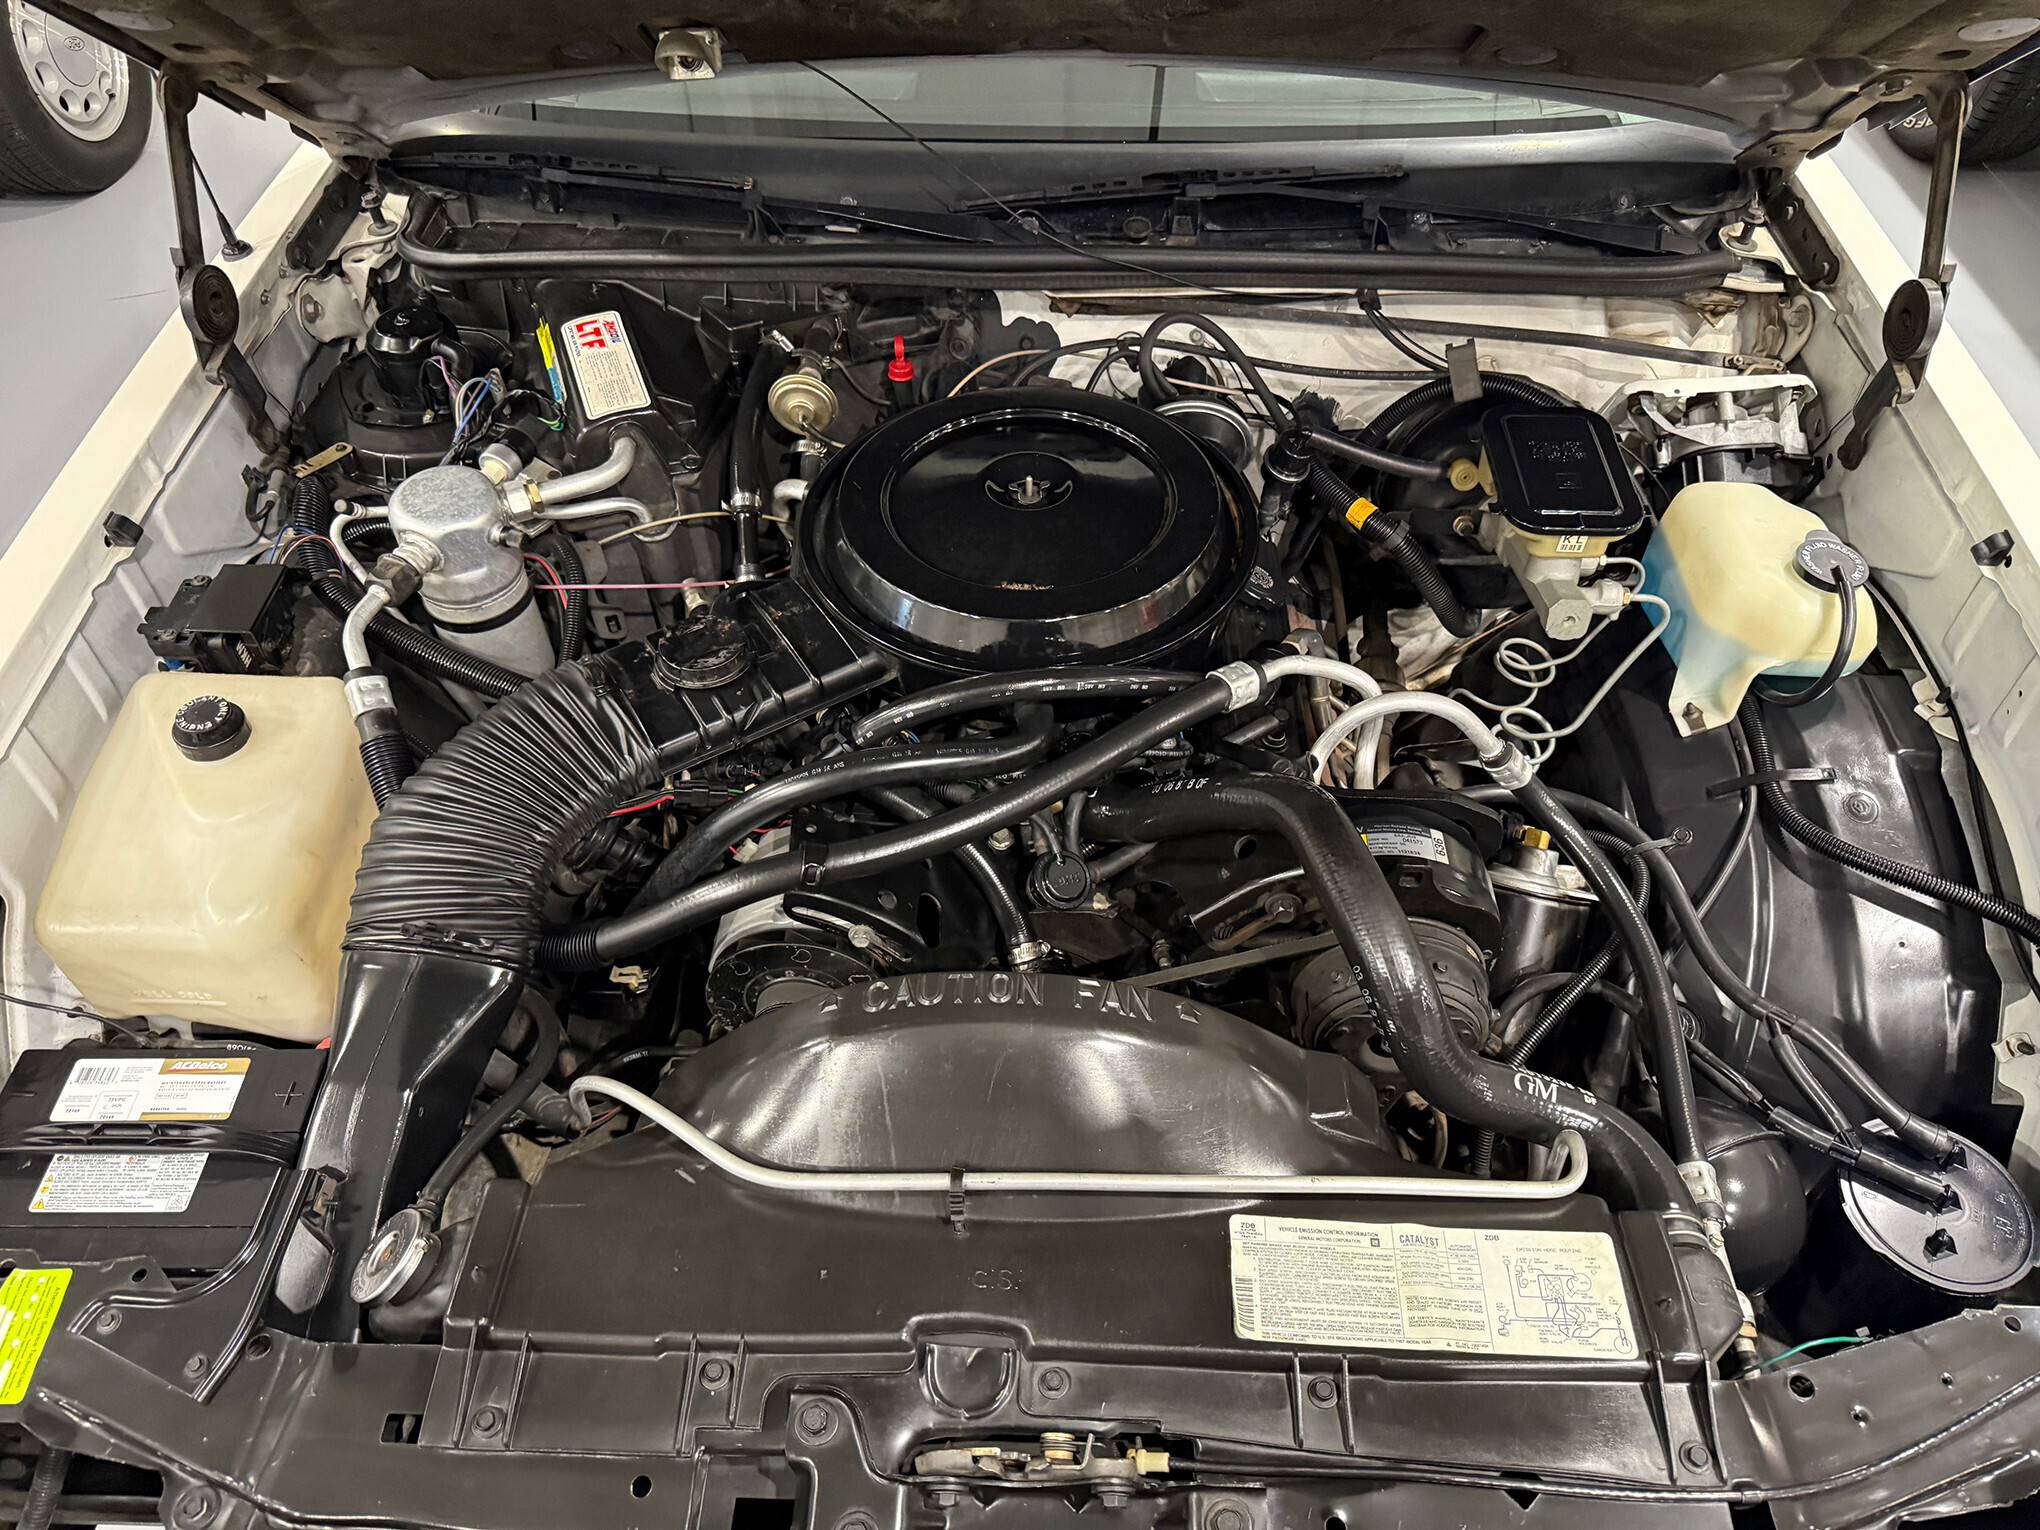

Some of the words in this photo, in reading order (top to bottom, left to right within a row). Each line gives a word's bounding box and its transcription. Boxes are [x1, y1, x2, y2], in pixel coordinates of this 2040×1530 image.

[575, 319, 607, 349] LTF
[176, 694, 223, 716] COOLANT
[213, 701, 230, 723] ONLY
[175, 716, 213, 730] ENGINE
[1433, 837, 1446, 857] 636
[1352, 965, 1364, 981] 03
[862, 972, 1045, 1014] CAUTION
[1072, 977, 1157, 1023] FAN
[168, 1060, 229, 1070] ACDelco
[1513, 1072, 1559, 1104] GM
[1399, 1234, 1439, 1247] CATALYST
